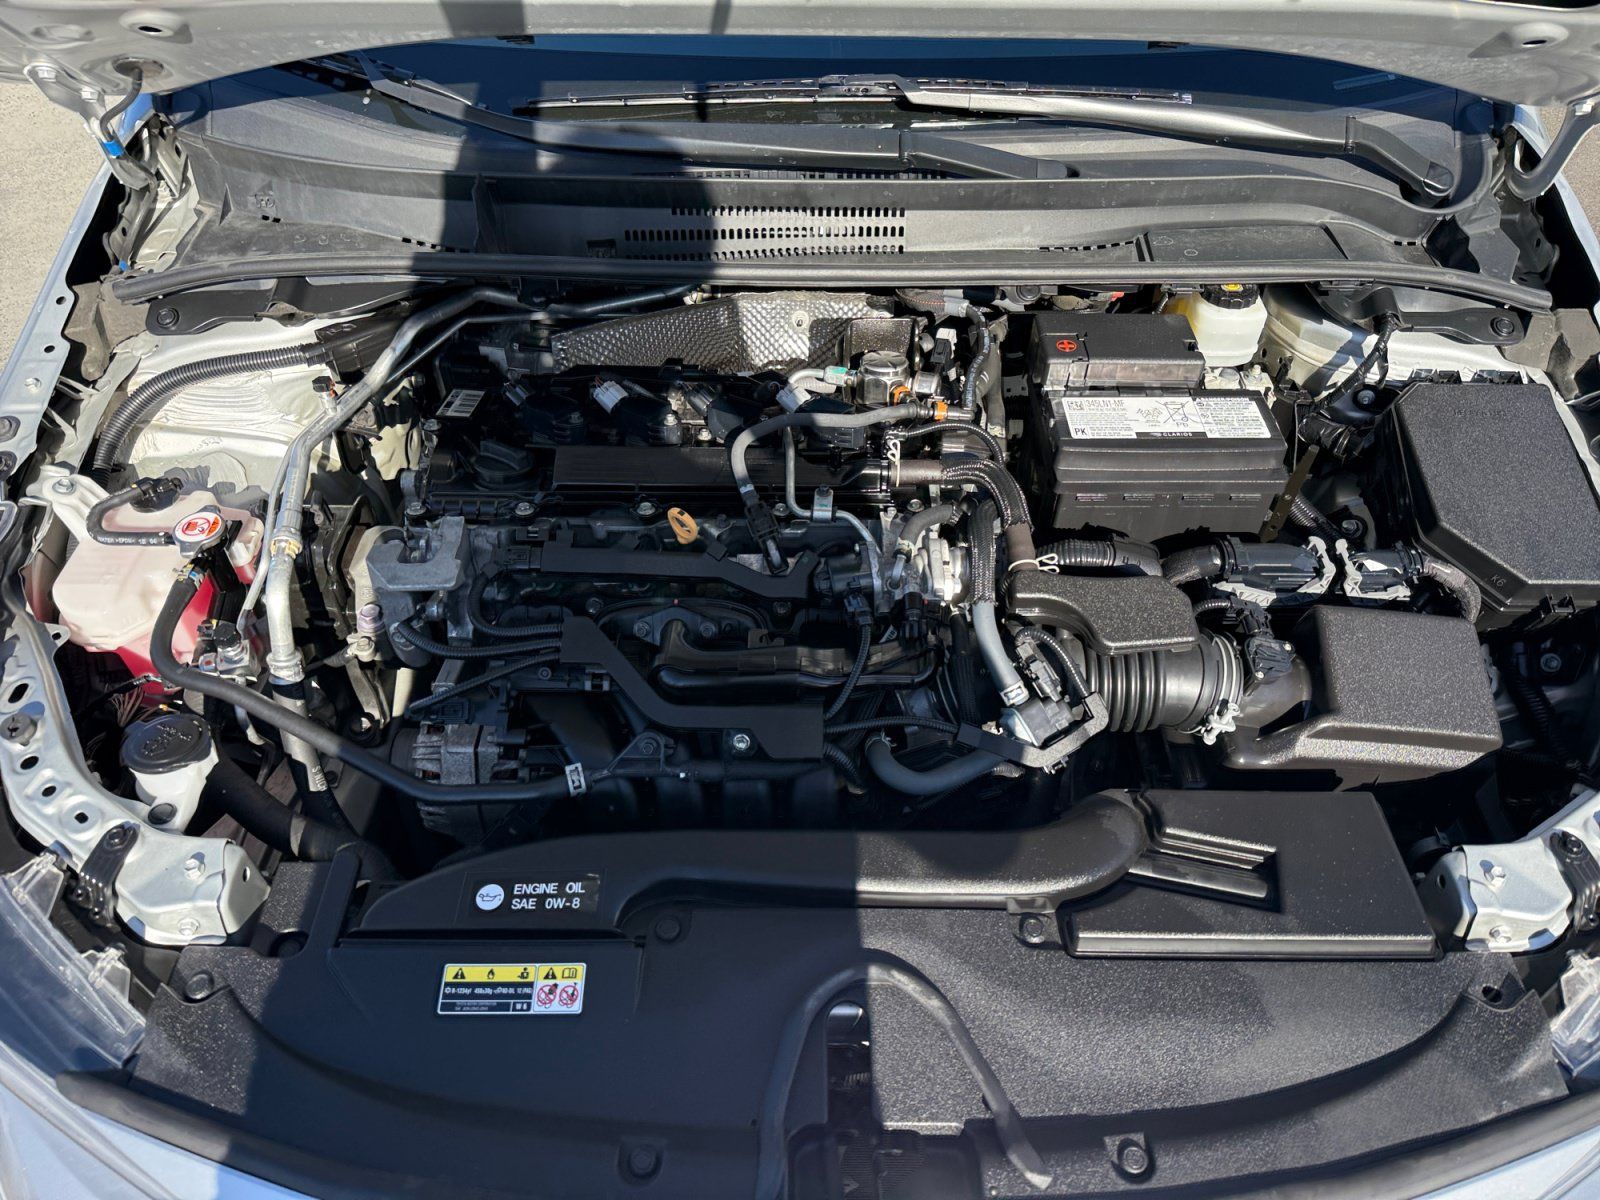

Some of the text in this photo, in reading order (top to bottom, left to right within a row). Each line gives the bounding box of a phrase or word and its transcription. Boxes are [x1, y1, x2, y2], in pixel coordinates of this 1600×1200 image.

[1074, 427, 1088, 436] PK
[513, 882, 586, 895] ENGINE OIL
[510, 897, 581, 910] SAE 0W-8
